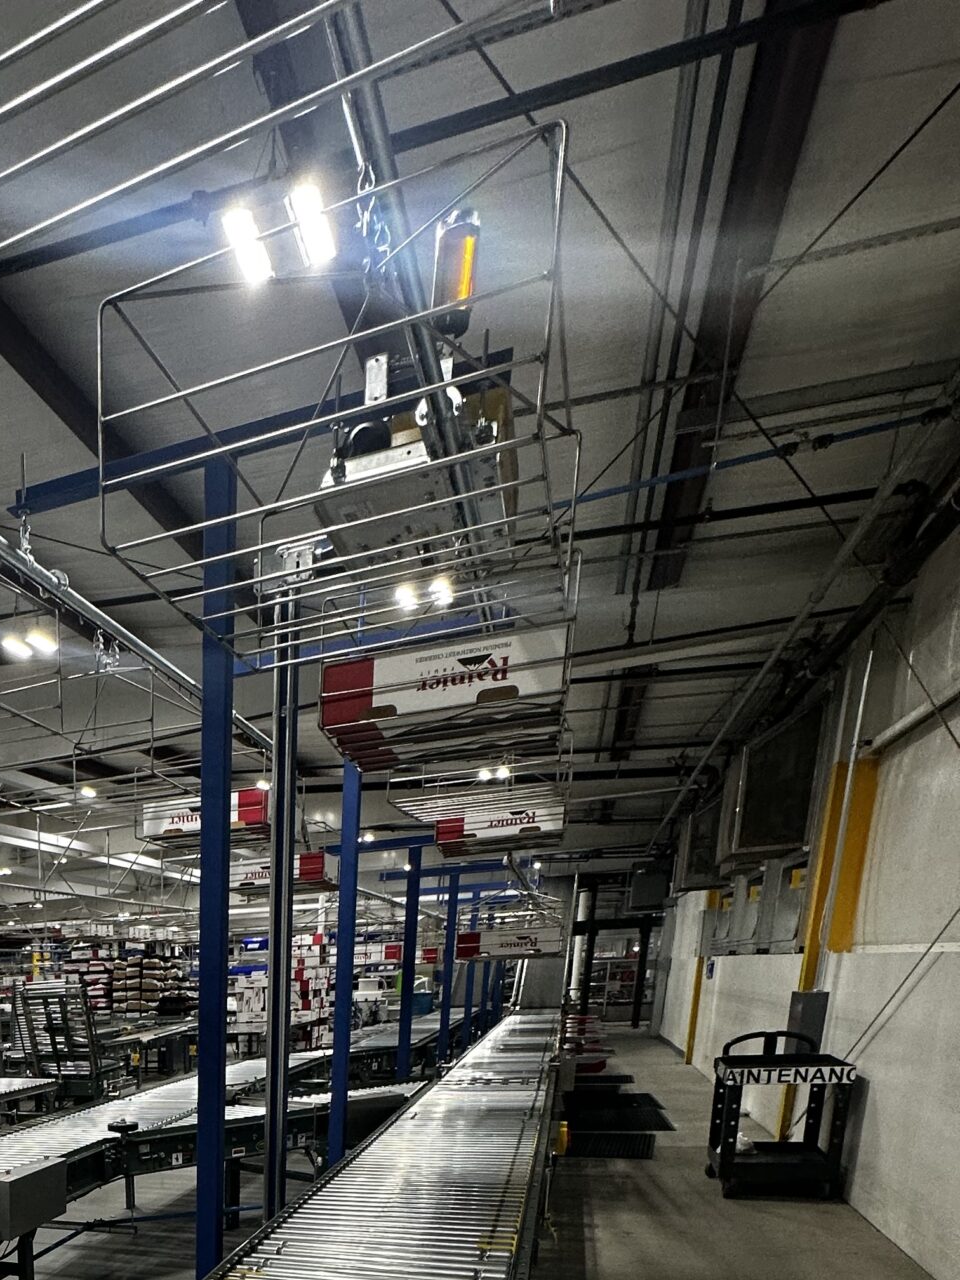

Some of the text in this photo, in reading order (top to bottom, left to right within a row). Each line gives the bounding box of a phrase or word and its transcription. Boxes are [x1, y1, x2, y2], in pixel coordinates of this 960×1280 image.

[416, 655, 510, 692] Rainier
[488, 810, 537, 828] Rainier
[499, 936, 539, 949] Rainier
